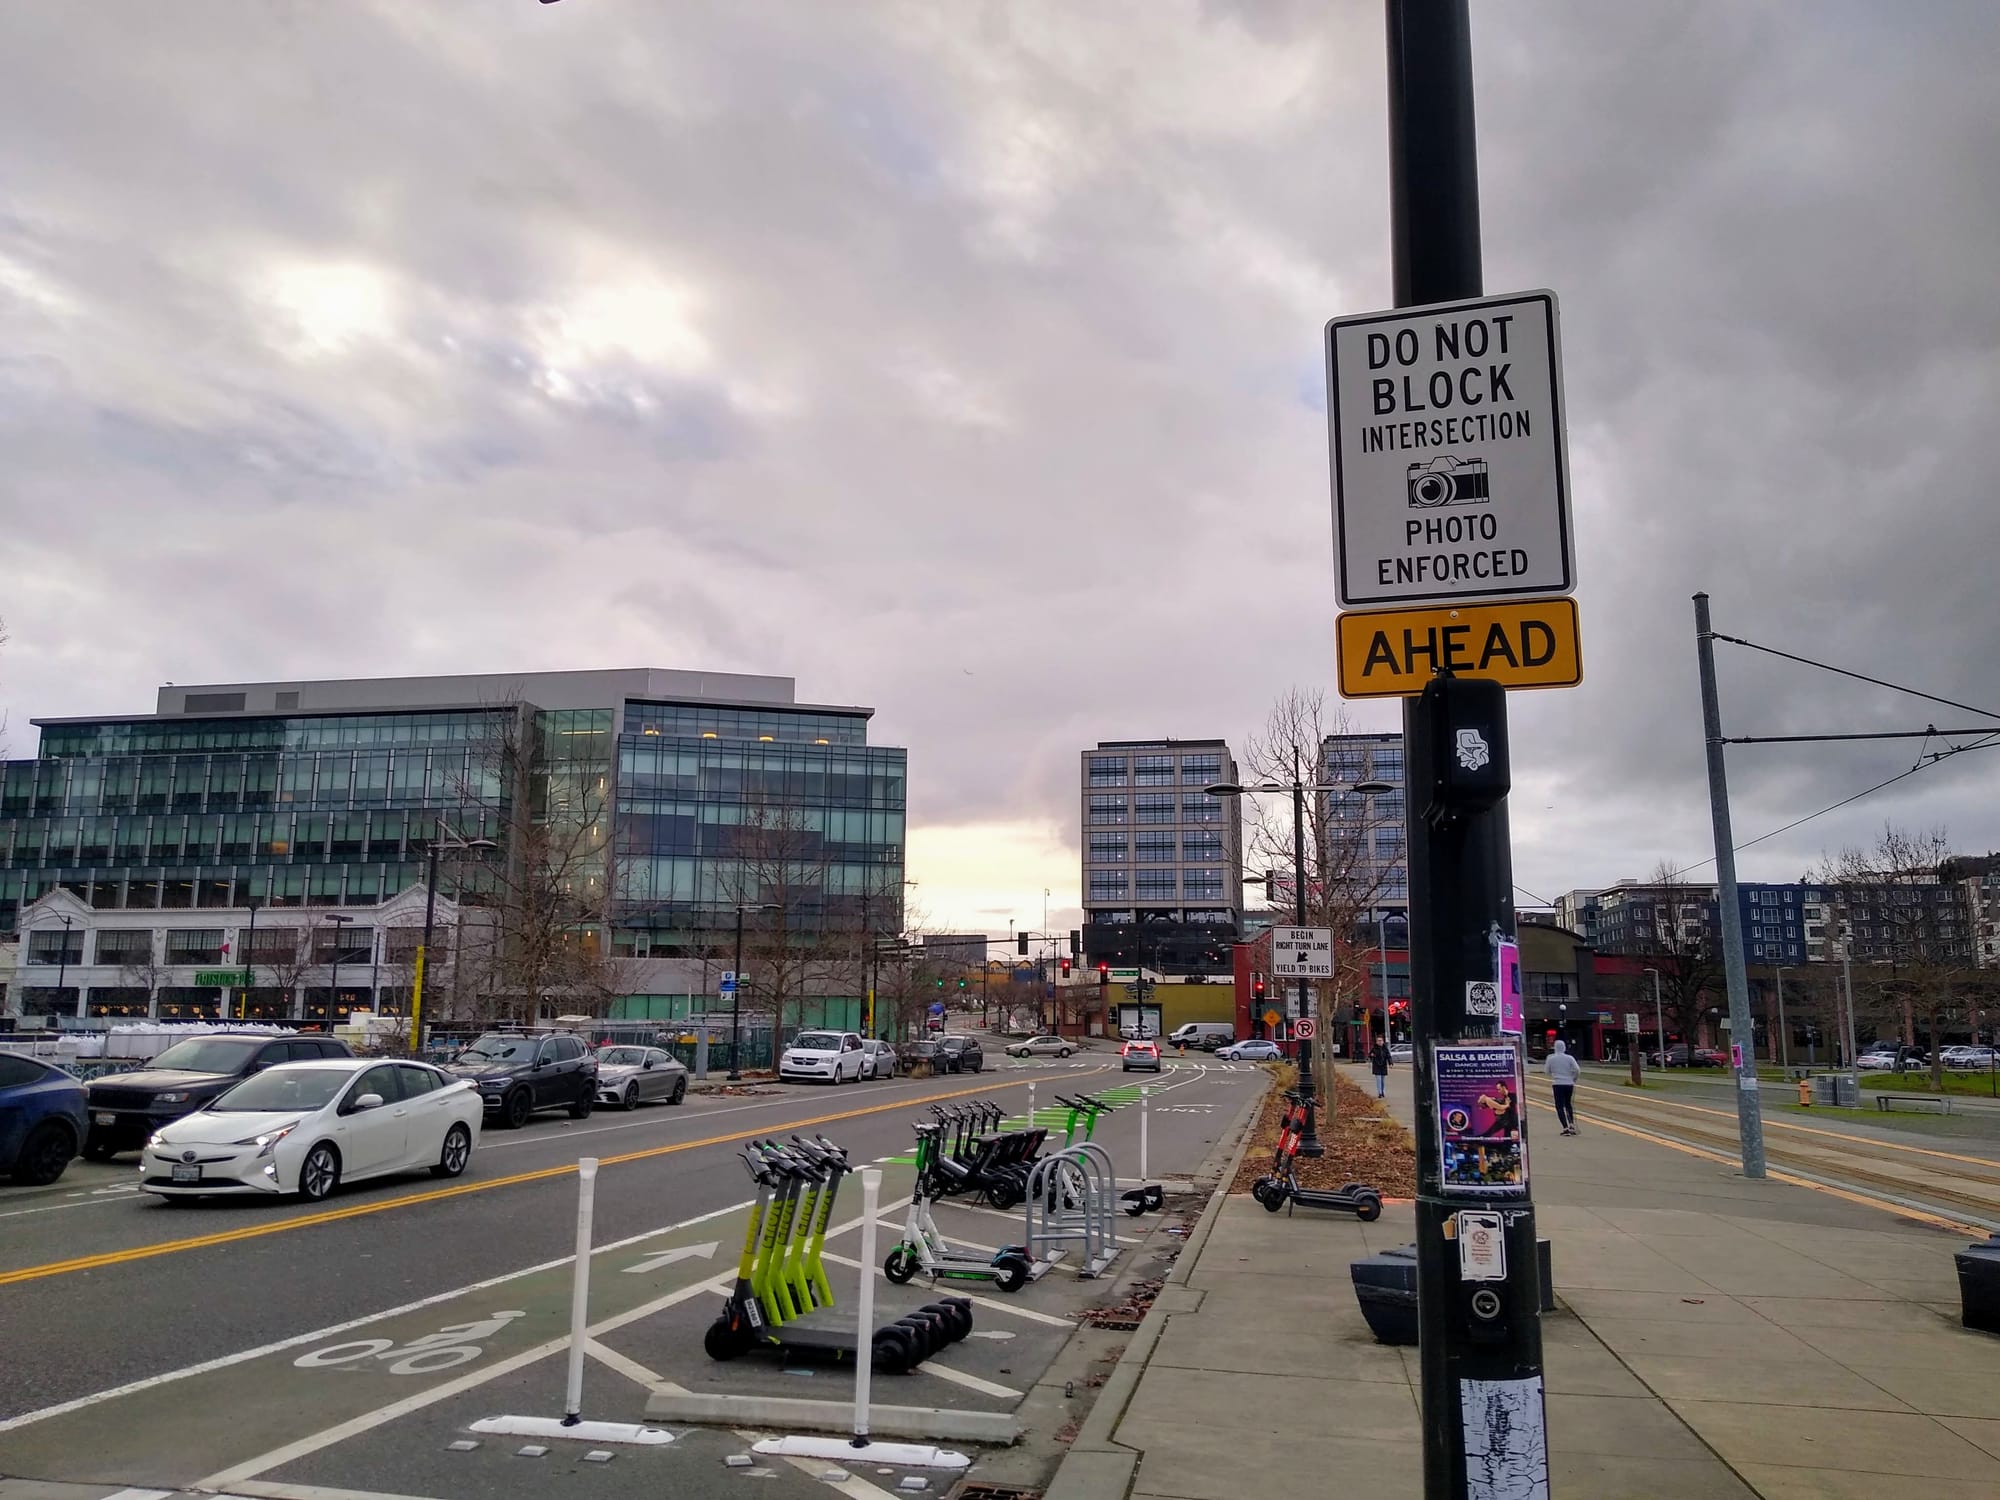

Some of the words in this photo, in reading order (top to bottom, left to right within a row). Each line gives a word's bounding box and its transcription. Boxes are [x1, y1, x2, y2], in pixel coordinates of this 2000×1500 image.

[1368, 328, 1419, 370] DO
[1436, 316, 1514, 361] NOT
[1373, 364, 1514, 415] BLOCK
[1362, 410, 1531, 453] INTERSECTION
[1406, 513, 1497, 546] PHOTO
[1378, 549, 1528, 584] ENFORCED
[1362, 620, 1556, 676] AHEAD
[1291, 931, 1313, 939] BEGIN
